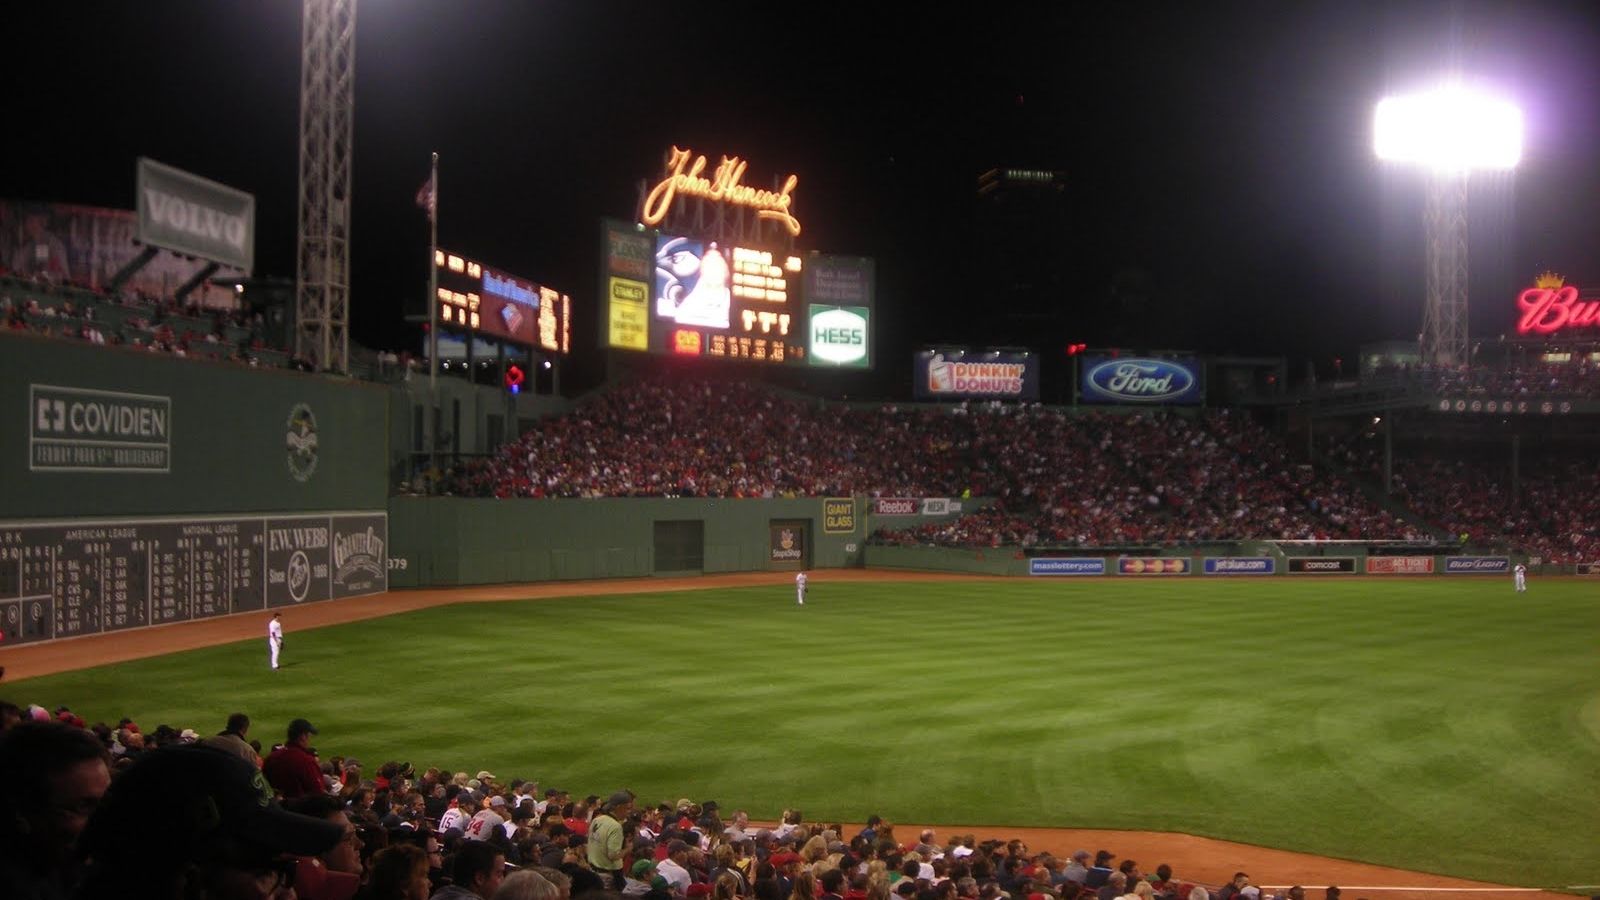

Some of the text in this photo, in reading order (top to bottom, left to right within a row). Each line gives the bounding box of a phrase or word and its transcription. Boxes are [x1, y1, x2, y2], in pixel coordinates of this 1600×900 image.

[643, 145, 801, 236] John Hancock
[145, 188, 245, 248] VOLVO
[815, 329, 862, 345] HESS
[955, 364, 1024, 377] DUNKIN'
[955, 378, 1022, 391] DONUTS
[1109, 363, 1173, 393] Ford
[70, 402, 166, 437] COVIDIEN
[827, 504, 851, 515] GIANT
[879, 500, 913, 513] Reebok
[826, 516, 852, 528] GLASS
[65, 528, 137, 540] AMERICAN LEAGUE
[183, 524, 238, 535] NATIONAL LEAGUE
[269, 527, 328, 551] F.W. WEBB
[1033, 563, 1103, 571] masslottery.com
[1306, 561, 1340, 569] comcast
[1476, 560, 1506, 568] LIGHT
[441, 817, 453, 829] 15
